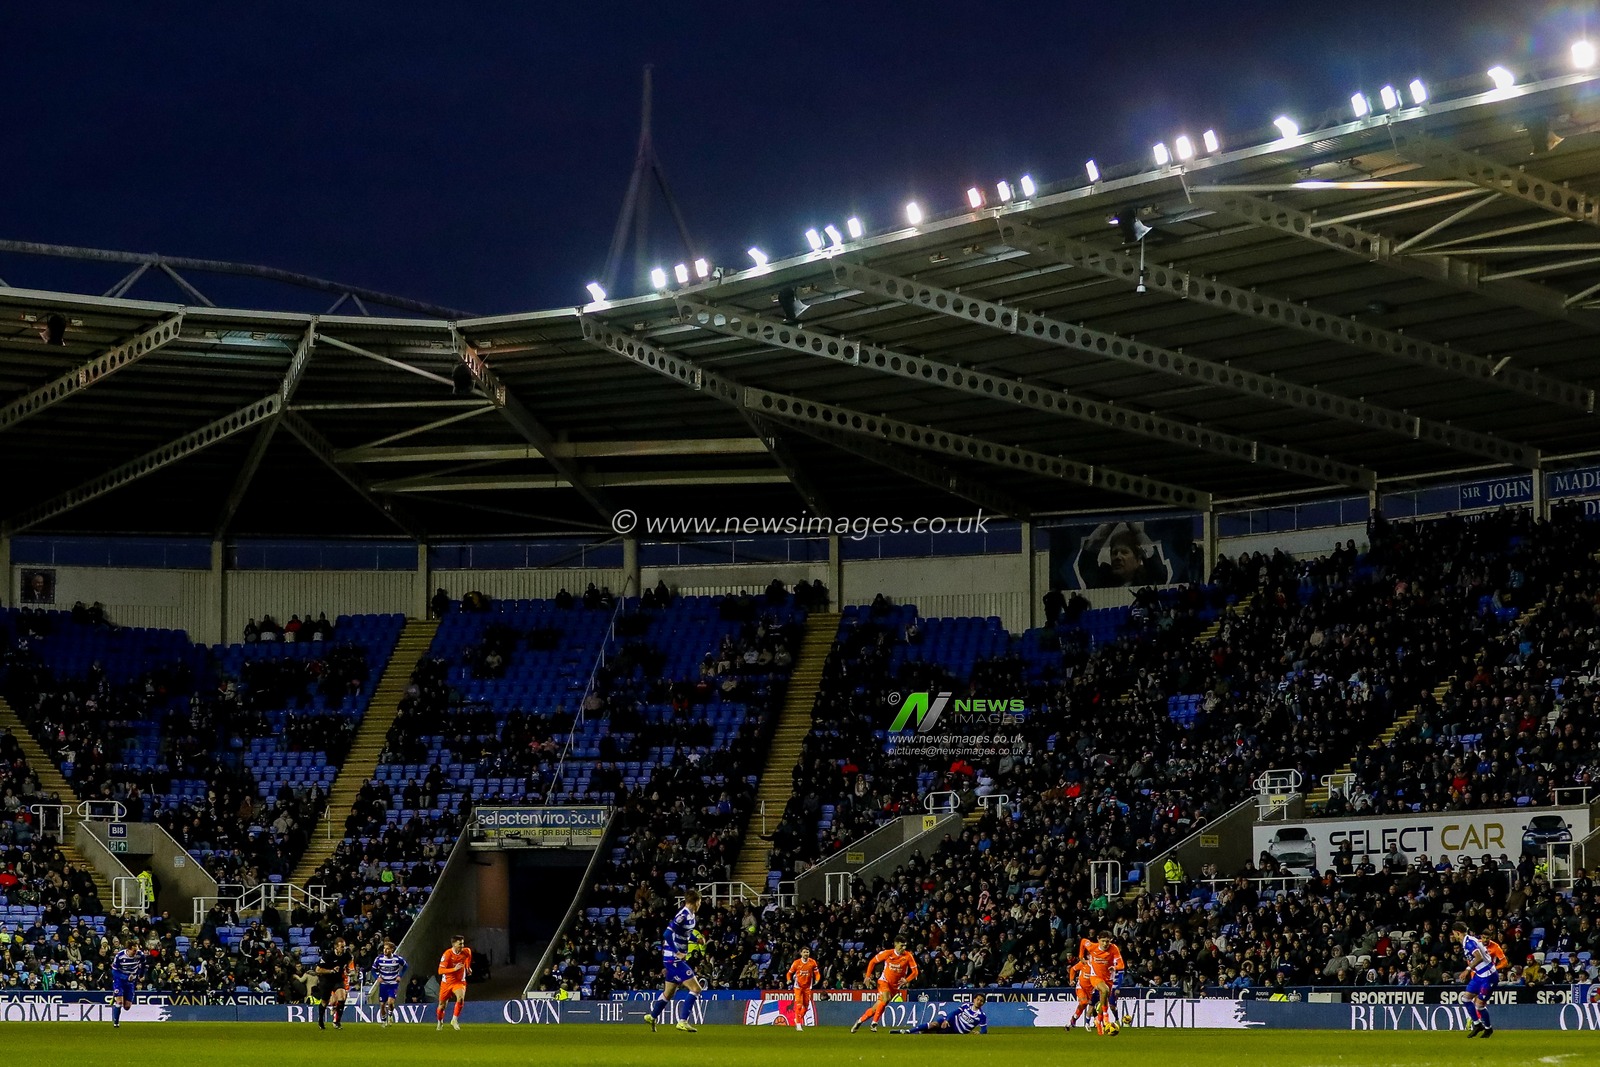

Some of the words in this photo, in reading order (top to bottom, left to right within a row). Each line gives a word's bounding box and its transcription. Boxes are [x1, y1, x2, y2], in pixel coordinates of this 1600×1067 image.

[1462, 486, 1481, 498] SIR
[1487, 479, 1531, 502] JOHN
[477, 810, 607, 825] selectenviro.co.uk
[111, 826, 124, 835] B18
[555, 828, 593, 837] BUSINESS
[1329, 826, 1434, 857] SELECT
[1440, 823, 1506, 850] CAR
[1350, 991, 1425, 1005] SPORTFIVE
[1440, 991, 1517, 1005] SPOFIVE
[354, 1005, 427, 1023] NOW
[503, 999, 560, 1024] OWN
[597, 1002, 624, 1022] THE
[1164, 999, 1200, 1028] KIT
[1351, 1005, 1405, 1030] BUY
